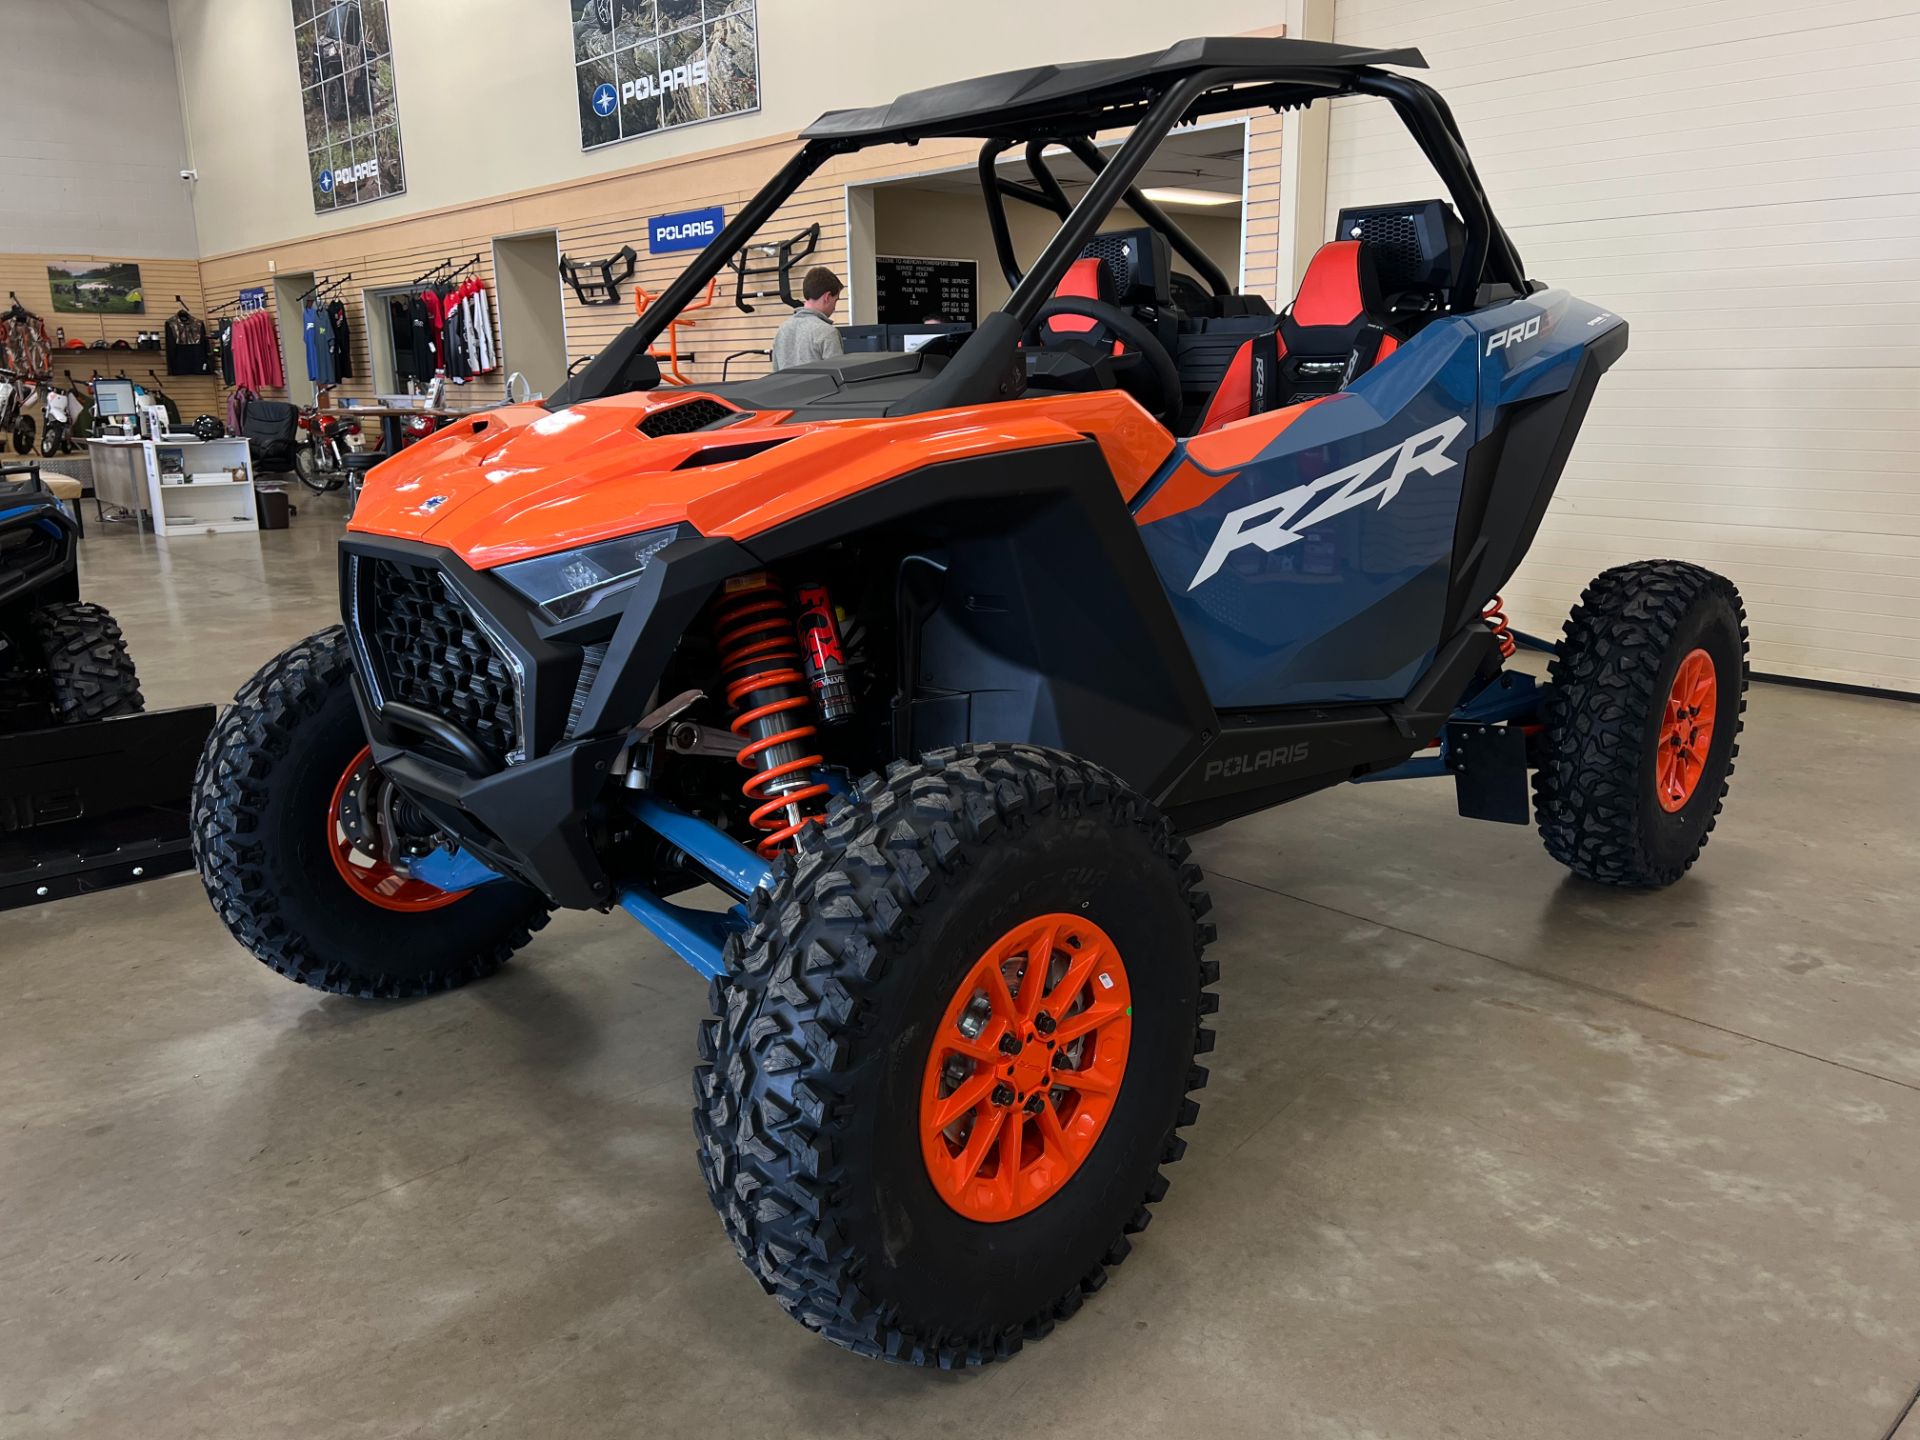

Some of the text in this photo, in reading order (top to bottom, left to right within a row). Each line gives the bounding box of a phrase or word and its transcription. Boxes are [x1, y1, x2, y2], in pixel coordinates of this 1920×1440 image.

[622, 60, 708, 105] POLARIS
[334, 159, 377, 186] POLARIS
[656, 220, 714, 242] POLARIS
[1485, 315, 1541, 357] PRO
[1256, 357, 1265, 397] RZR
[1187, 415, 1467, 592] RZR
[1204, 742, 1310, 782] POLARIS
